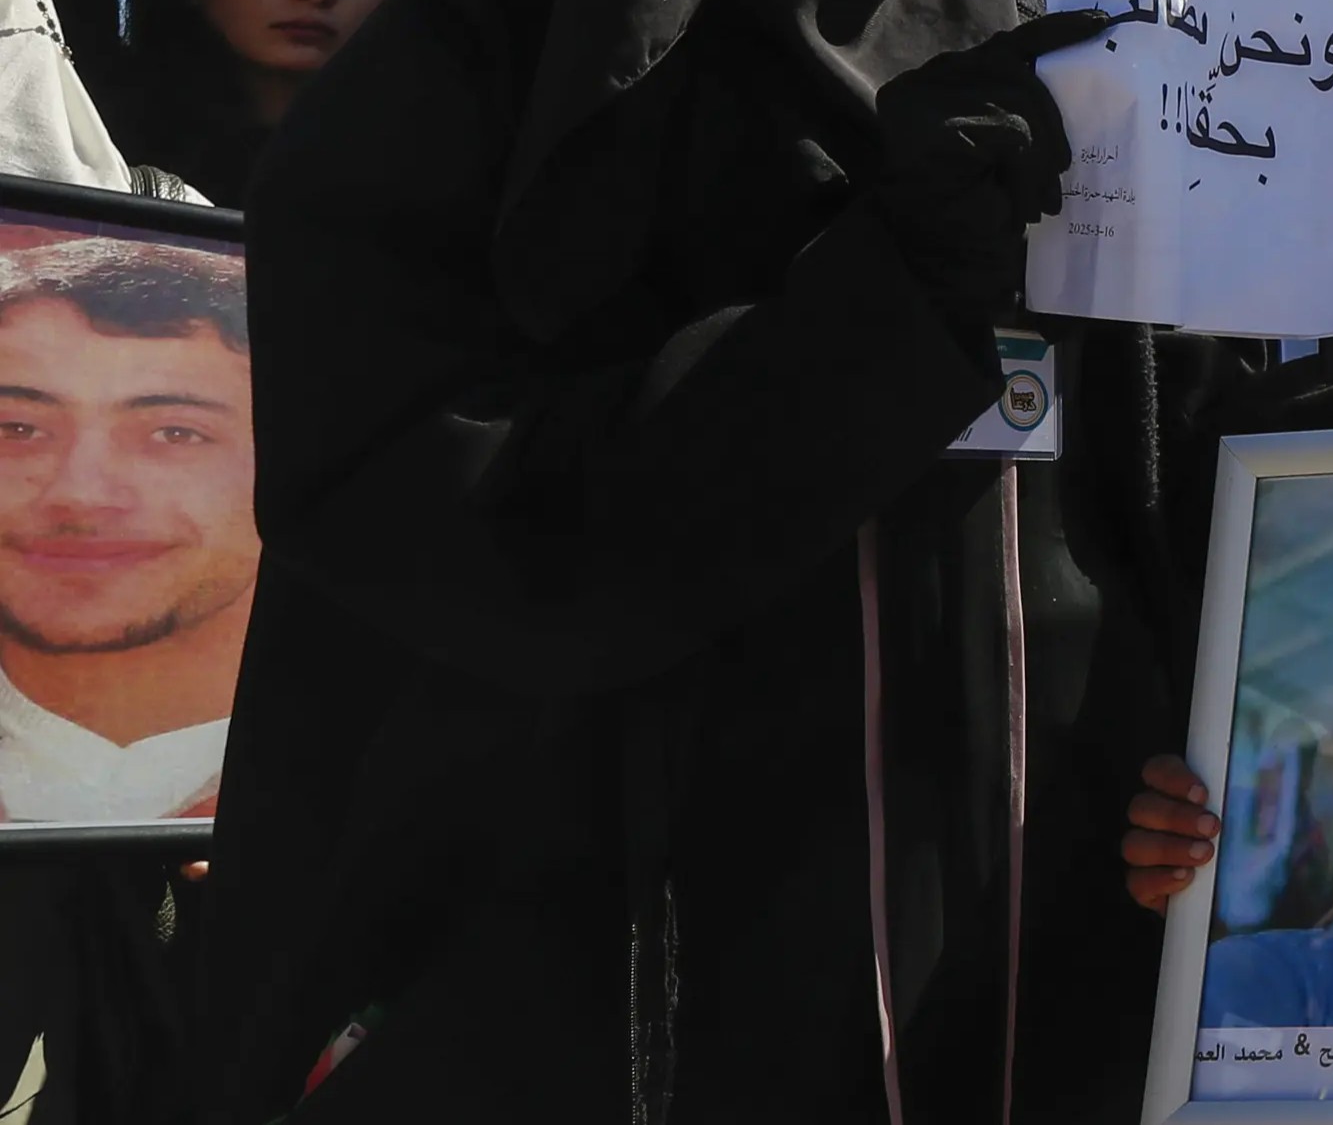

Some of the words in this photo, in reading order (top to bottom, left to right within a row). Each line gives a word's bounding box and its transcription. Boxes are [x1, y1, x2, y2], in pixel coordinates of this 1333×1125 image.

[1068, 222, 1115, 237] 2025-3-16
[1293, 1033, 1311, 1057] &
[1234, 1046, 1283, 1063] محمد
